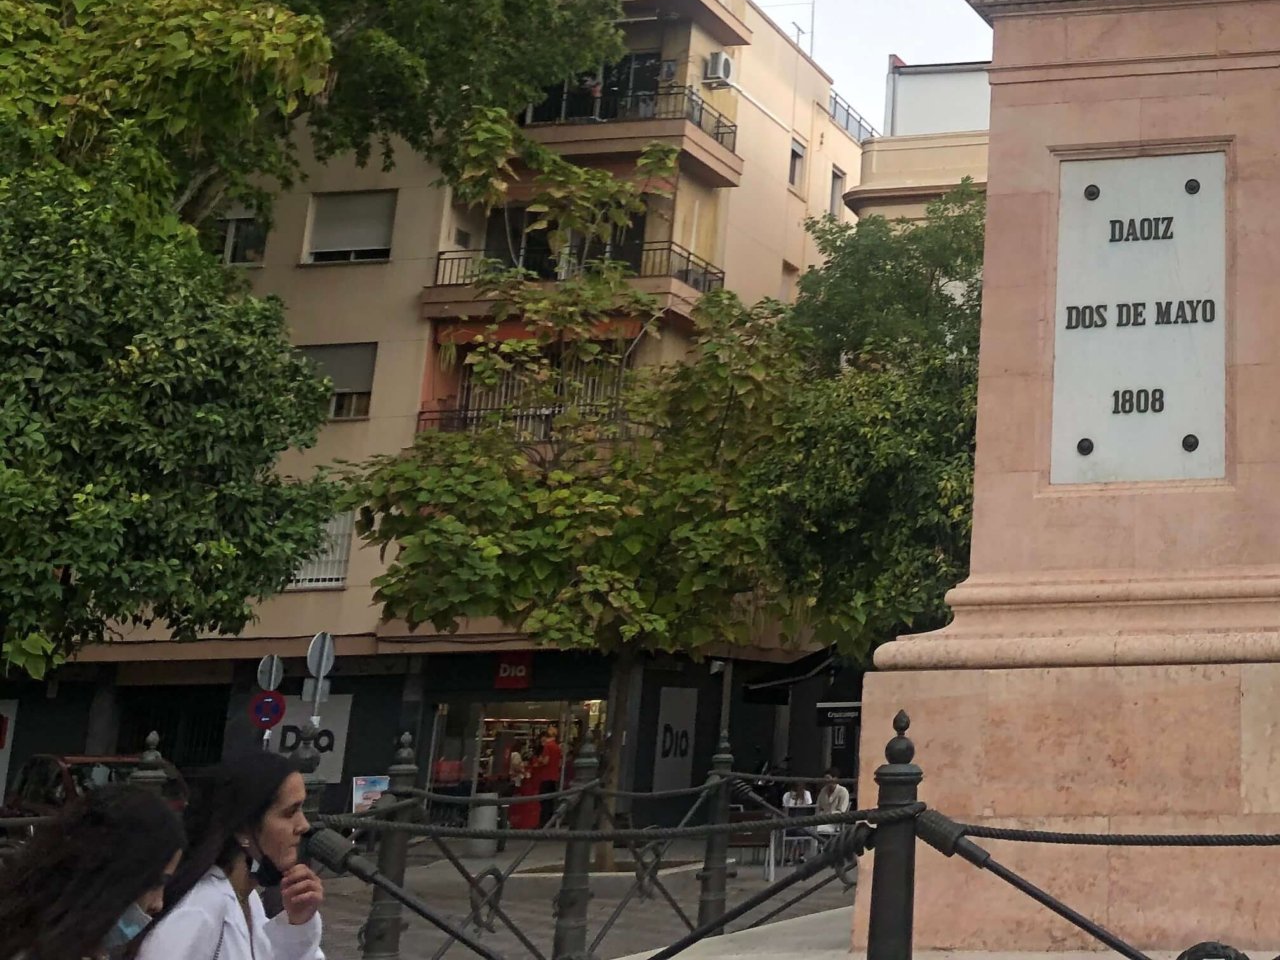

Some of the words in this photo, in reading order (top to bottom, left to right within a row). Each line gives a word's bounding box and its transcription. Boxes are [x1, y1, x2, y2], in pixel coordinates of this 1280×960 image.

[1109, 217, 1174, 243] DAOIZ
[1066, 305, 1108, 330] DOS
[1116, 303, 1147, 328] DE
[1155, 300, 1216, 326] MAYO
[1112, 389, 1165, 415] 1808
[279, 725, 335, 753] Da
